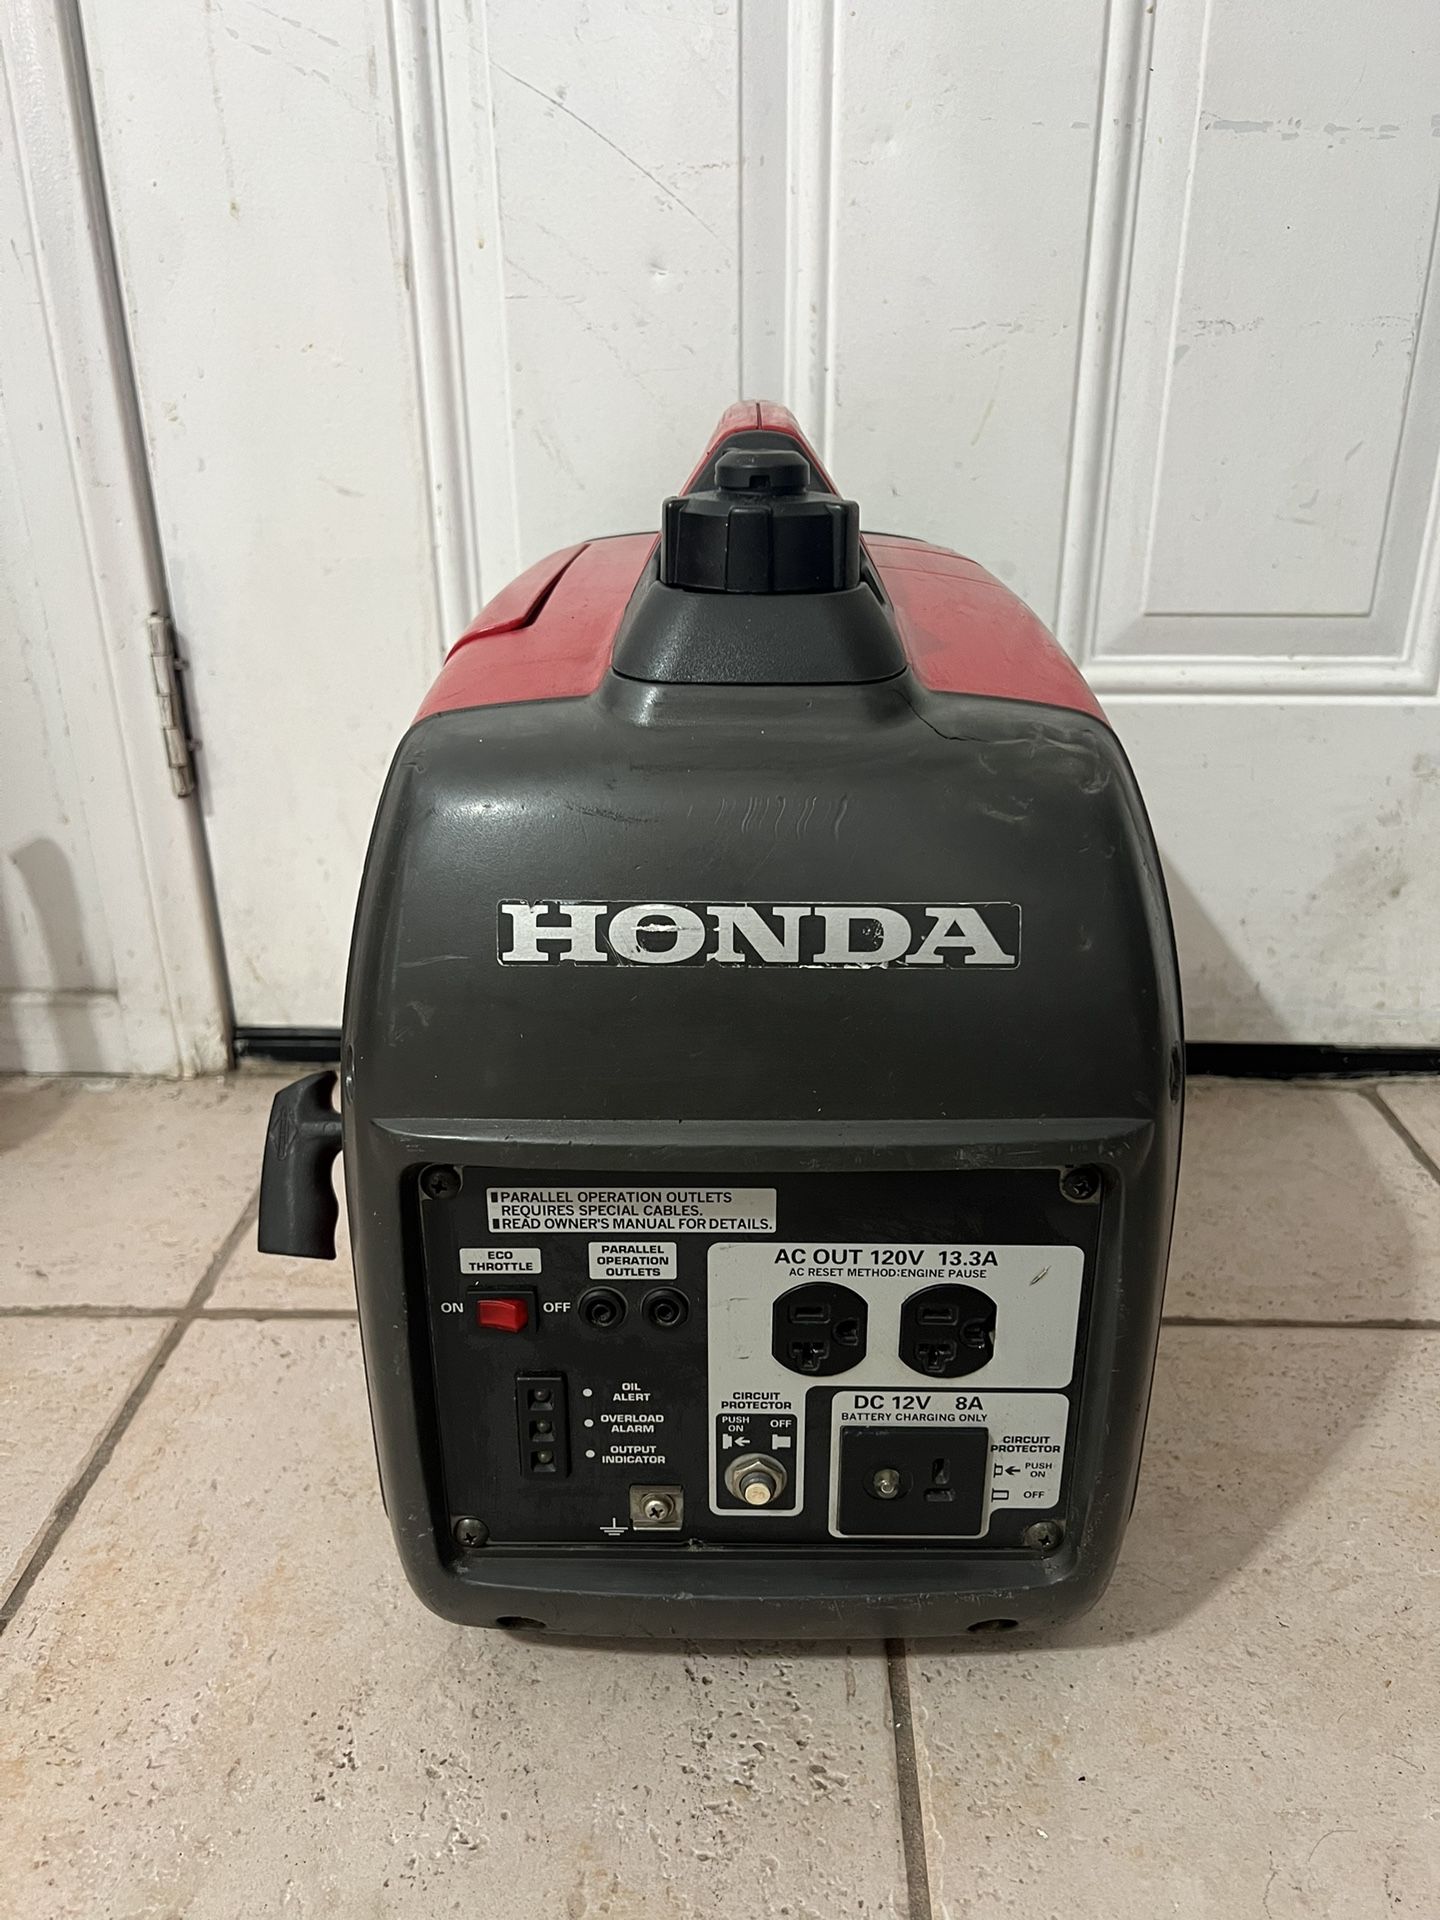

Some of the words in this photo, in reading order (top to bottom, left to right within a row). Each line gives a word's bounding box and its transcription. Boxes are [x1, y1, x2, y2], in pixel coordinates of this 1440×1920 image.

[501, 904, 1015, 964] HONDA
[501, 1191, 573, 1203] PARALLEL
[577, 1191, 662, 1203] OPERATION
[666, 1191, 733, 1204] OUTLETS
[501, 1205, 575, 1218] REQUIRES
[579, 1205, 640, 1217] SPECIAL
[643, 1205, 703, 1217] CABLES.
[502, 1218, 541, 1230] READ
[543, 1218, 610, 1230] OWNER'S
[613, 1218, 676, 1231] MANUAL
[678, 1218, 708, 1231] FOR
[709, 1218, 773, 1231] DETAILS.
[601, 1245, 665, 1253] PARALLEL
[487, 1251, 514, 1259] ECO
[774, 1248, 806, 1264] AC
[812, 1249, 863, 1264] OUT
[870, 1249, 924, 1265] 120V
[939, 1250, 999, 1266] 13.3A
[596, 1256, 670, 1265] OPERATION
[468, 1262, 534, 1270] THROTTLE
[605, 1267, 661, 1276] OUTLETS
[788, 1267, 804, 1277] AC
[809, 1267, 843, 1277] RESET
[846, 1267, 944, 1278] METHOD:ENGINE
[948, 1268, 987, 1278] PAUSE
[440, 1302, 464, 1313] ON
[542, 1301, 572, 1313] OFF
[621, 1382, 642, 1391] OIL
[612, 1392, 651, 1401] ALERT
[732, 1391, 781, 1400] CIRCUIT
[720, 1400, 793, 1410] PROTECTOR
[854, 1395, 885, 1410] DC
[891, 1395, 932, 1410] 12V
[955, 1396, 984, 1410] 8A
[600, 1413, 665, 1423] OVERLOAD
[721, 1415, 750, 1424] PUSH
[841, 1412, 893, 1422] BATTERY
[895, 1412, 956, 1423] CHARGING
[959, 1413, 989, 1423] ONLY
[727, 1424, 744, 1432] ON
[769, 1418, 793, 1428] OFF
[611, 1424, 655, 1433] ALARM
[1003, 1435, 1051, 1445] CIRCUIT
[610, 1445, 657, 1454] OUTPUT
[991, 1444, 1062, 1454] PROTECTOR
[602, 1455, 666, 1464] INDICATOR
[1025, 1461, 1053, 1470] PUSH
[1030, 1470, 1046, 1478] ON
[1023, 1489, 1045, 1499] OFF
